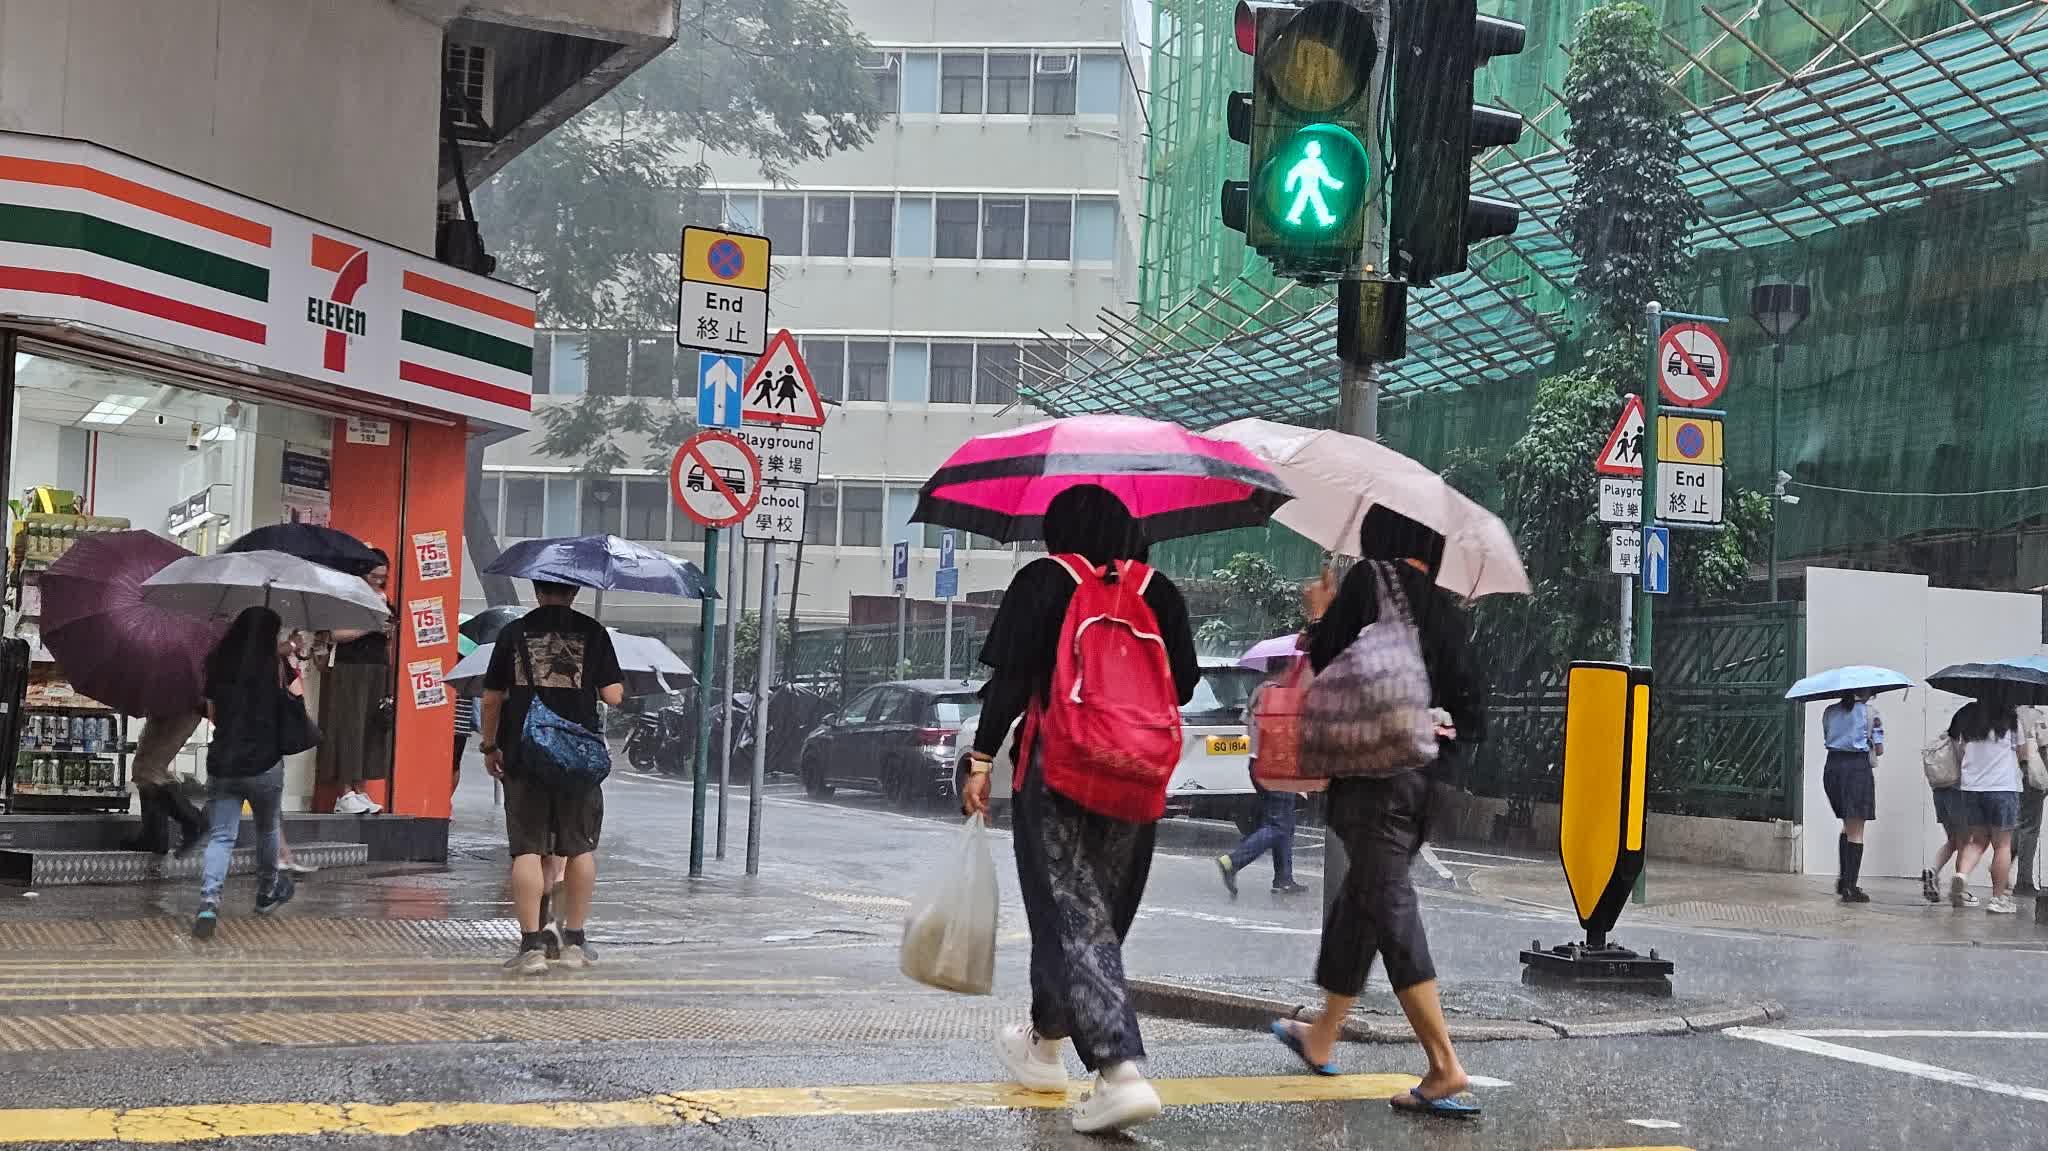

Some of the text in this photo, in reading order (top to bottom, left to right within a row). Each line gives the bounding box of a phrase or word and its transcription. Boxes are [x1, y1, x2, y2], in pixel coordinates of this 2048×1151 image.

[311, 233, 368, 373] 7
[706, 292, 743, 313] End
[696, 316, 748, 344] 終止
[1676, 471, 1705, 487] End
[759, 495, 799, 508] chool
[1669, 492, 1709, 514] 終止
[756, 514, 793, 533] 學校
[416, 544, 437, 561] 75
[942, 534, 953, 566] P
[895, 547, 906, 576] P
[413, 610, 434, 627] 75
[412, 671, 433, 689] 75
